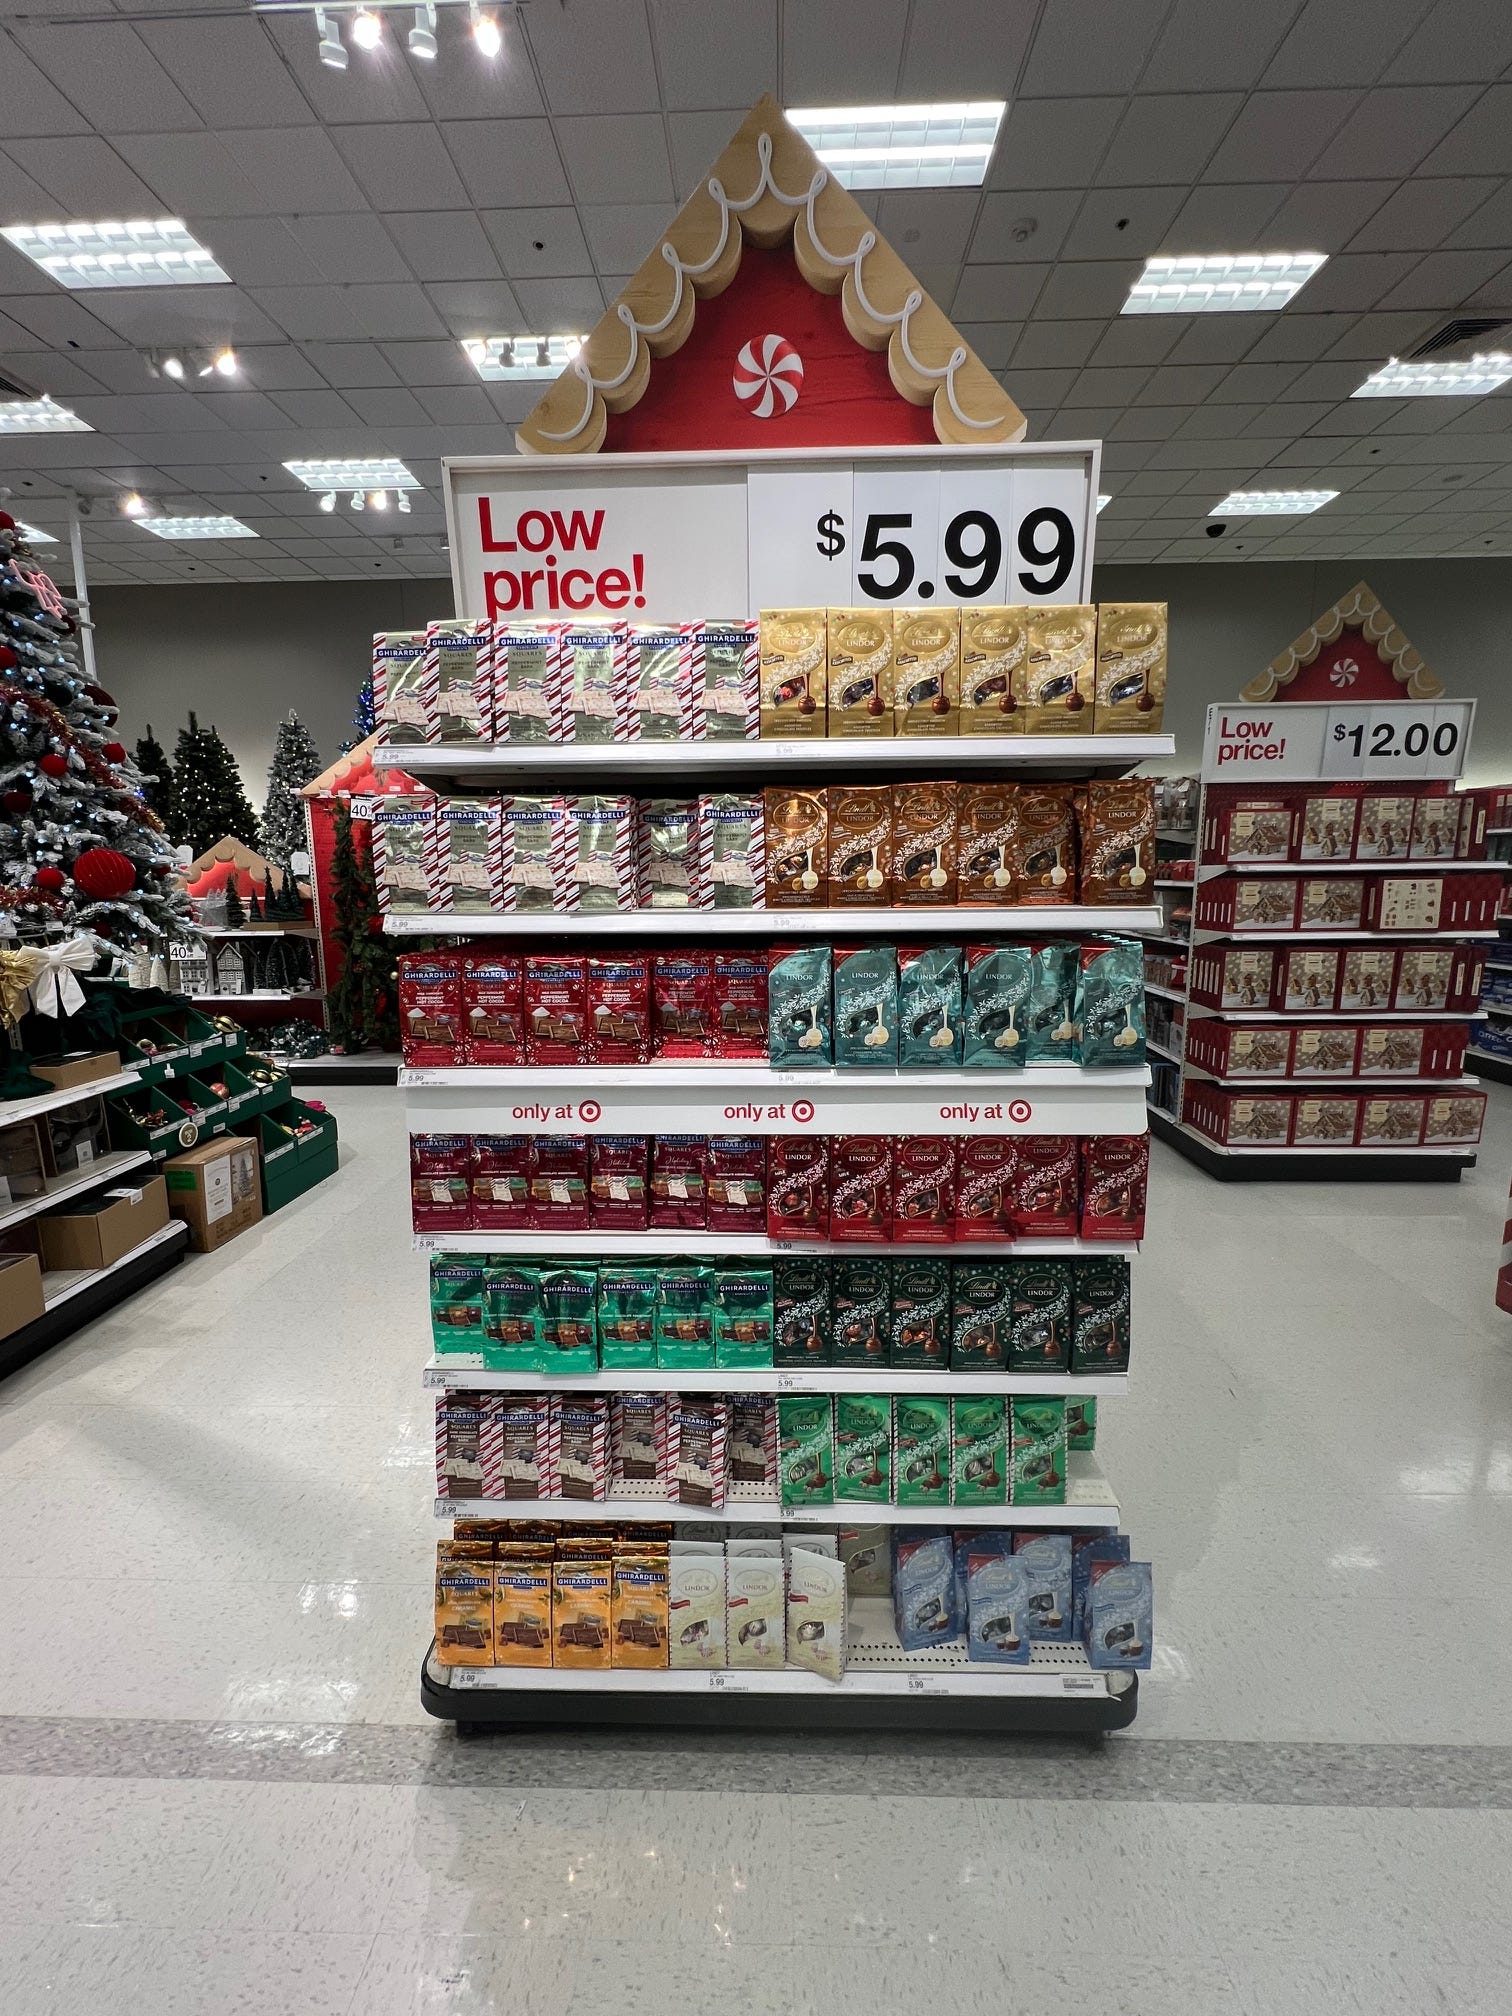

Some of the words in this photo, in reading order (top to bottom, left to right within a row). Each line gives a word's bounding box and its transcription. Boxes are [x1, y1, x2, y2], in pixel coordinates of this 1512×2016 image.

[479, 497, 605, 552] Low
[484, 553, 647, 622] price!
[432, 638, 483, 646] GHIRARDELLI
[1221, 717, 1273, 738] Low
[1333, 722, 1458, 757] $12.00
[1218, 739, 1286, 765] price!
[377, 813, 430, 821] GHIRARDELLI
[644, 815, 694, 823] GHIRARDELLI
[513, 1104, 550, 1122] only
[555, 1105, 572, 1118] at
[724, 1103, 763, 1122] only
[768, 1105, 785, 1118] at
[940, 1103, 979, 1122] only
[984, 1104, 1002, 1118] at
[555, 1413, 599, 1421] GHIRARDELLI
[675, 1416, 720, 1426] GHIRARDELLI
[915, 1567, 938, 1575] LINDOR
[804, 1582, 828, 1592] LINDOR
